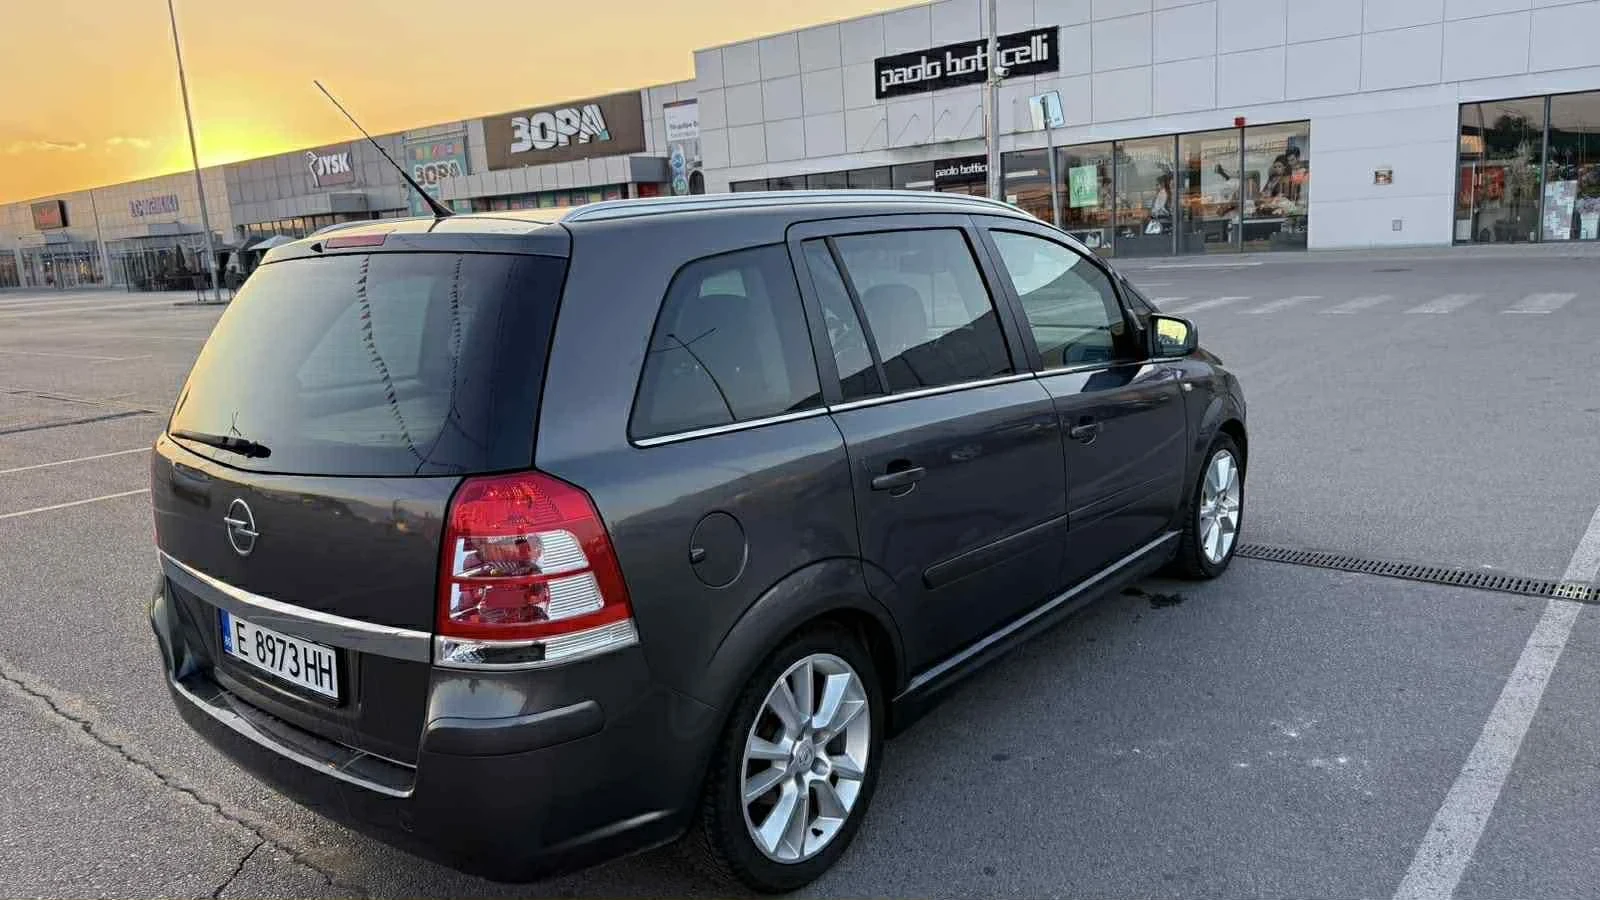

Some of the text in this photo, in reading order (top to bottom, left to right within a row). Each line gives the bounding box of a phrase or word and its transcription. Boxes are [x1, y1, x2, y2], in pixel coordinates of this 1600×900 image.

[881, 55, 941, 92] paolo
[511, 104, 610, 152] ЗОРА
[318, 153, 350, 176] JYSK
[936, 165, 959, 178] paolo
[236, 622, 334, 690] E 8973 HH
